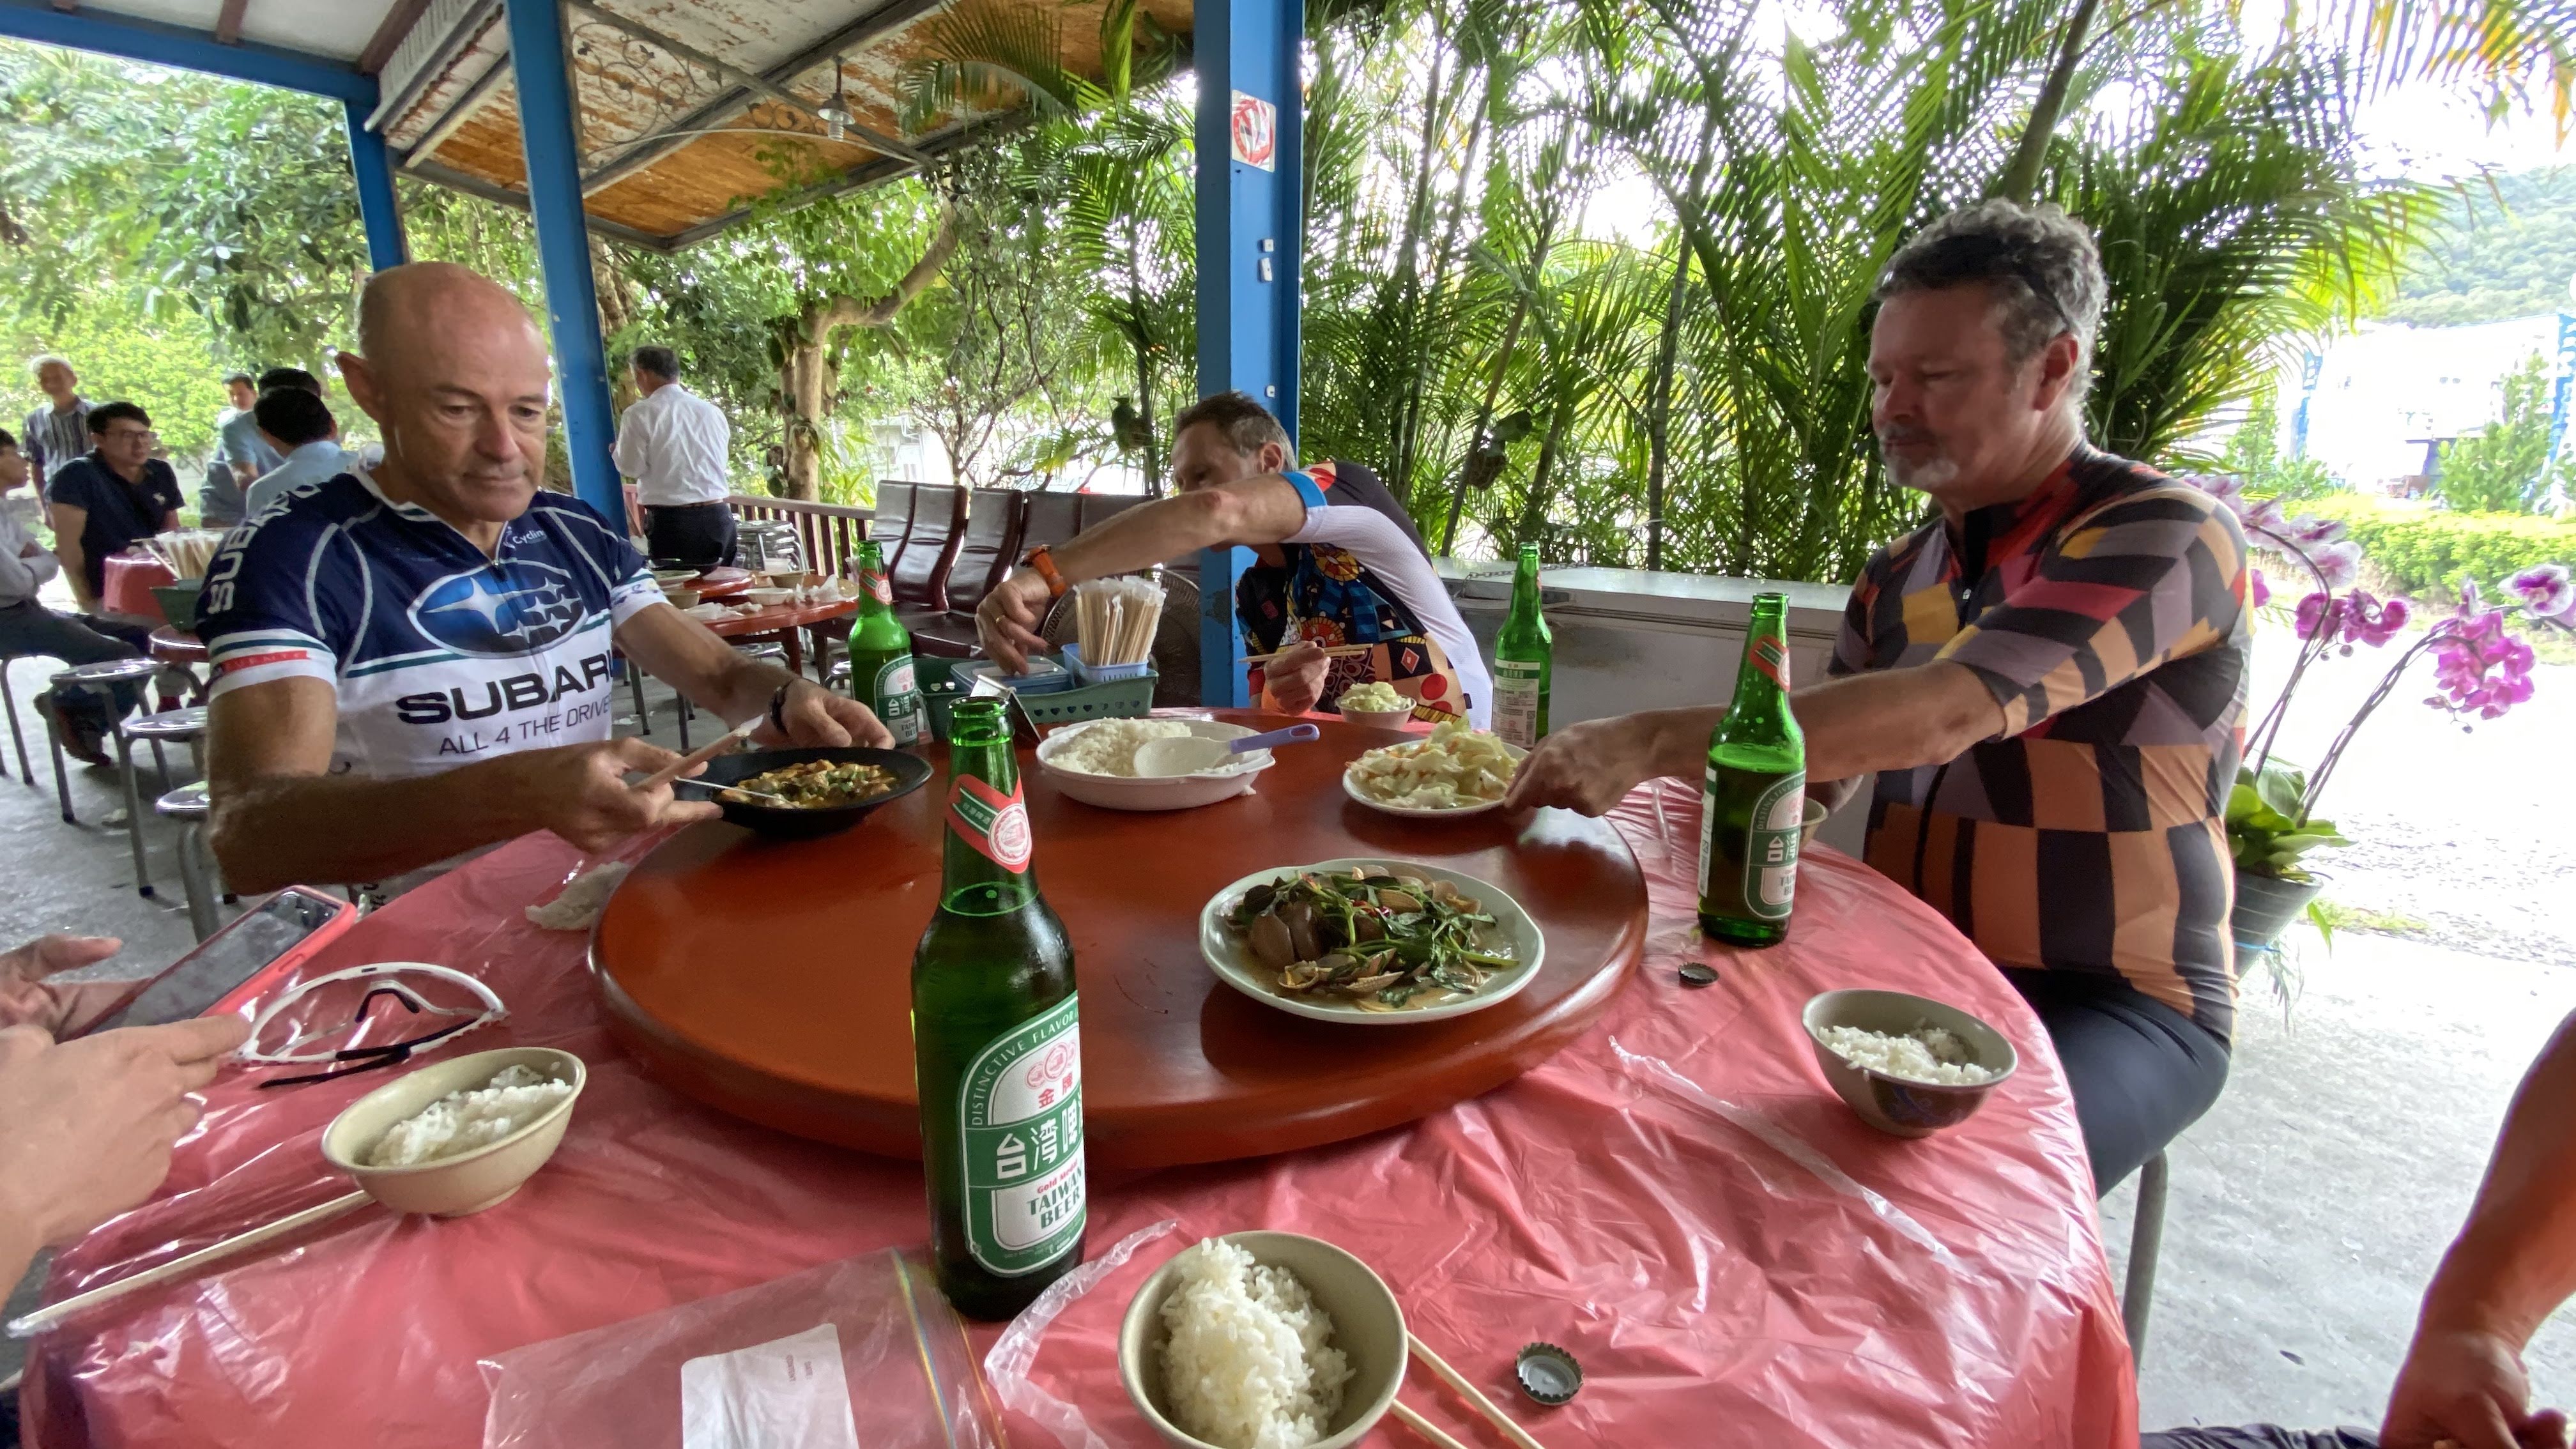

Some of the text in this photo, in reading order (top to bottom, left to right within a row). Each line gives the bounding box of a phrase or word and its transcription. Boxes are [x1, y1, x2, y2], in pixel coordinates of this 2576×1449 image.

[396, 649, 613, 724] SUBAR
[440, 693, 612, 755] ALL 4 THE DRIVE
[972, 1011, 1073, 1126] DISTINCTIVE FLAVOR
[1039, 1072, 1073, 1109] 金牌
[1026, 1158, 1082, 1215] TAIWAN
[1038, 1177, 1057, 1194] Gold
[1041, 1186, 1080, 1229] BEER
